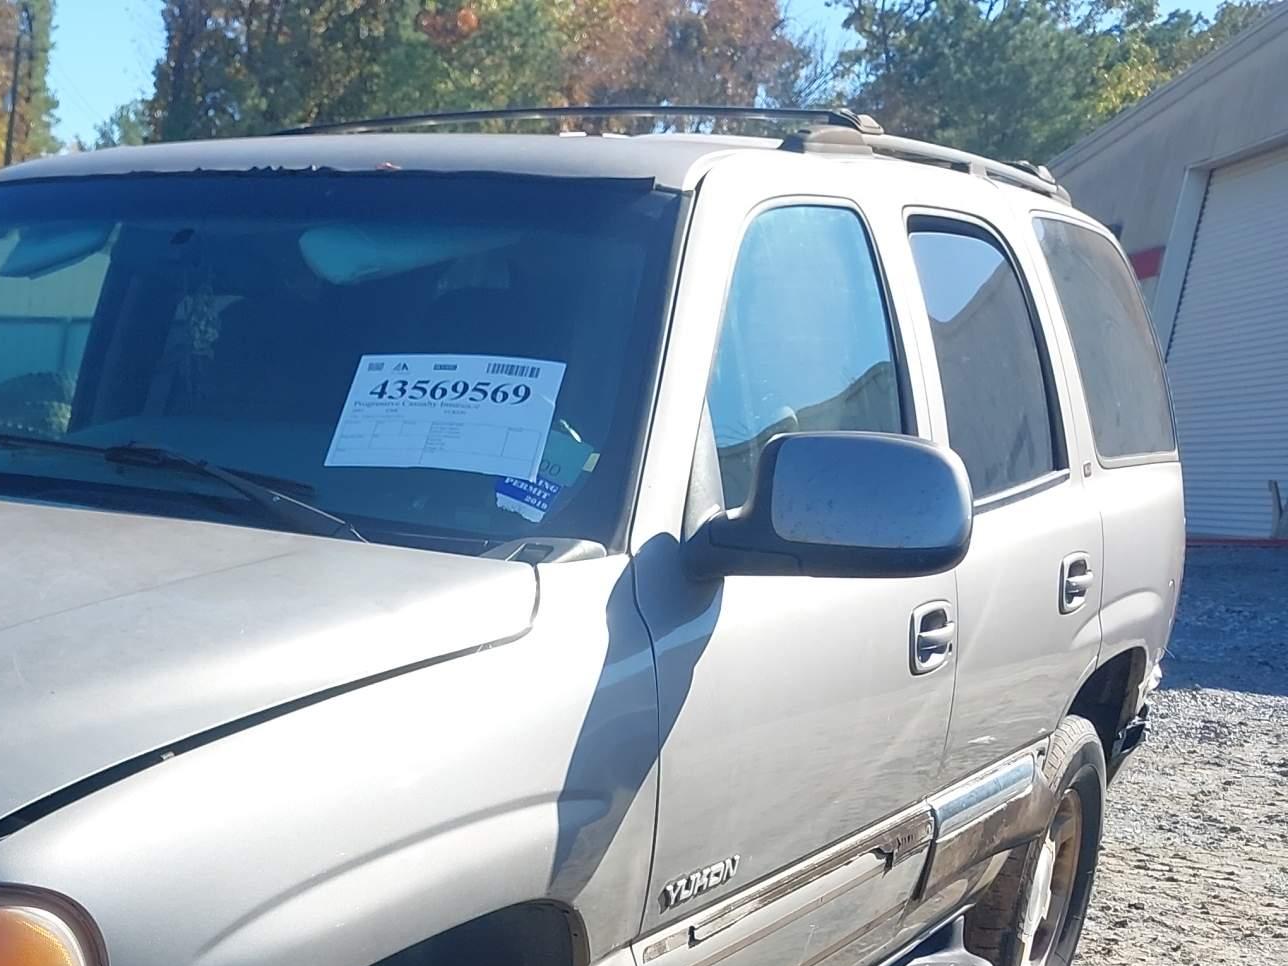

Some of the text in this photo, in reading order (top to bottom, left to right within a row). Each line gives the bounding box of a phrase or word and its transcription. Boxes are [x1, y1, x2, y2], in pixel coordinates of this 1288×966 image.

[369, 379, 531, 406] 43569569
[505, 477, 551, 500] PERMIT
[665, 854, 741, 905] YUKON
